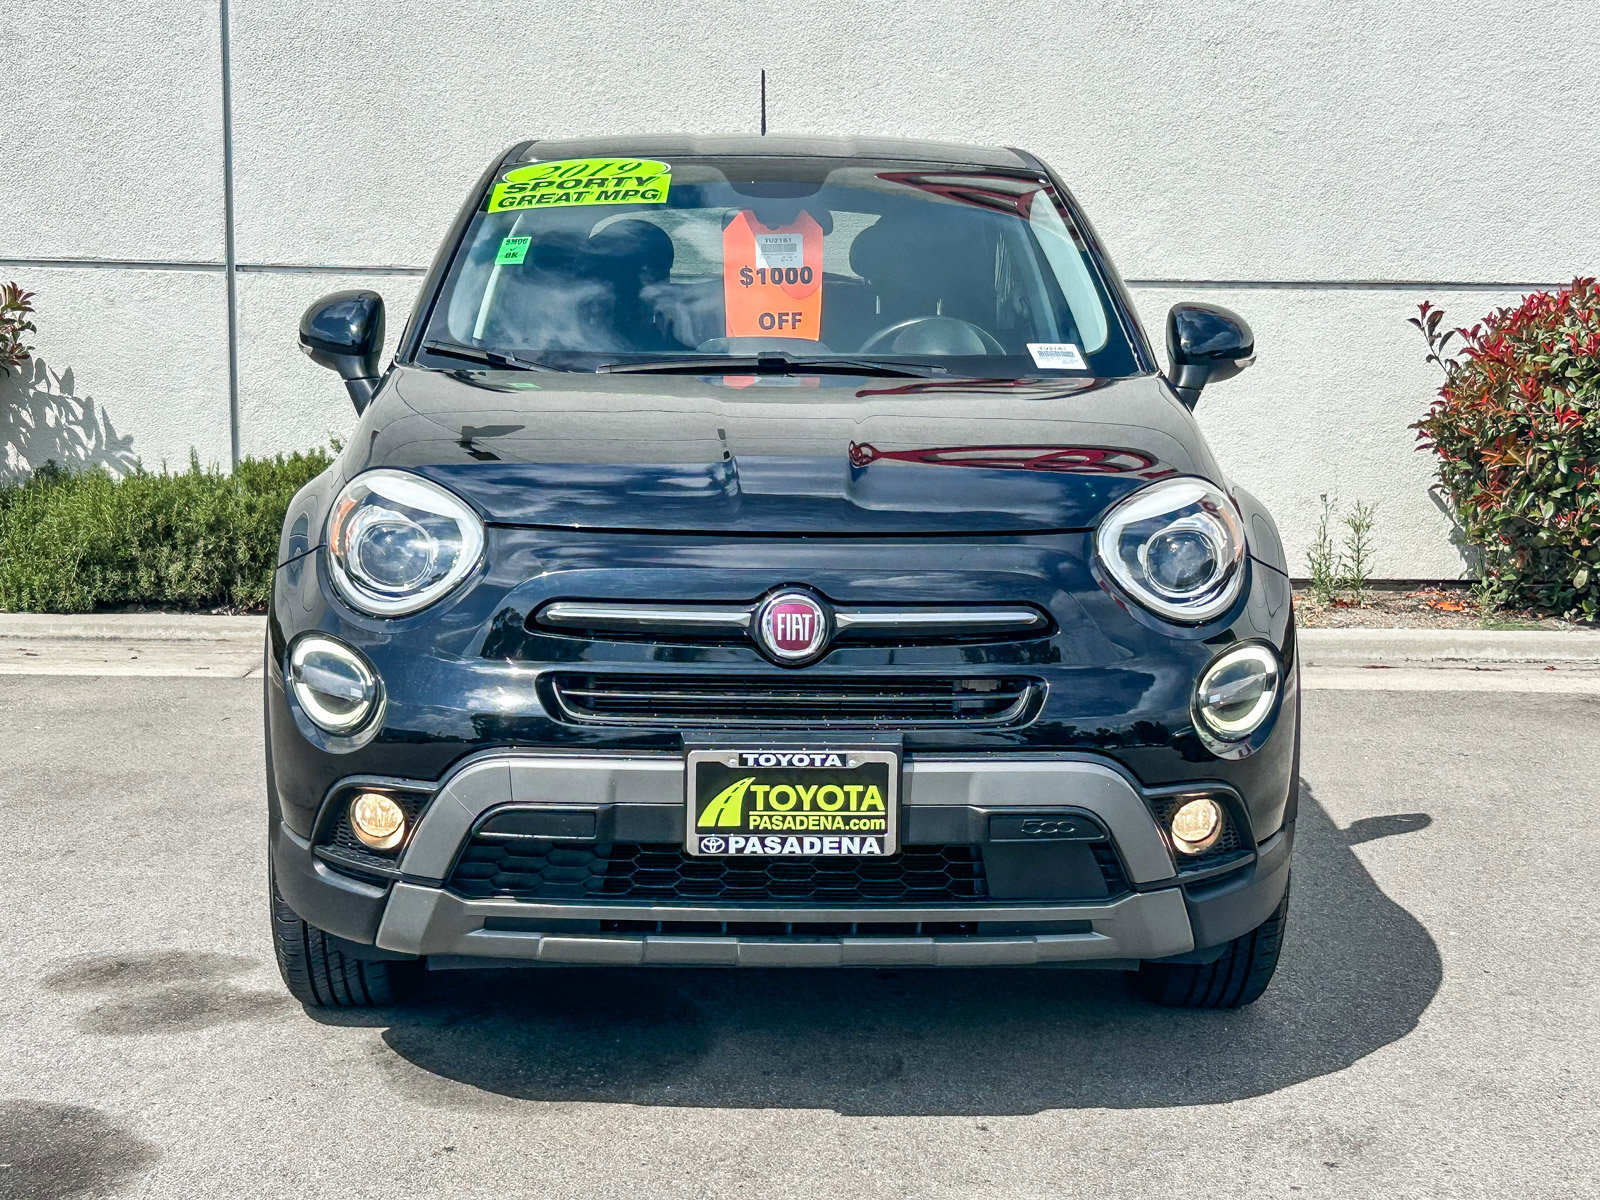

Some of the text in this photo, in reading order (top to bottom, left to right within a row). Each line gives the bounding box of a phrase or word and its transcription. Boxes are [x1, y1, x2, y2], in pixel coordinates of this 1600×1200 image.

[528, 162, 642, 181] 2019
[504, 176, 661, 194] SPORTY
[498, 189, 662, 209] GREAT MPG
[740, 265, 813, 288] $1000
[759, 312, 802, 330] OFF
[777, 613, 812, 640] FIAT
[743, 754, 842, 767] TOYOTA
[749, 785, 885, 811] TOYOTA
[749, 815, 886, 830] PASADENA.com
[1021, 819, 1076, 833] 500
[728, 837, 881, 854] PASADENA
